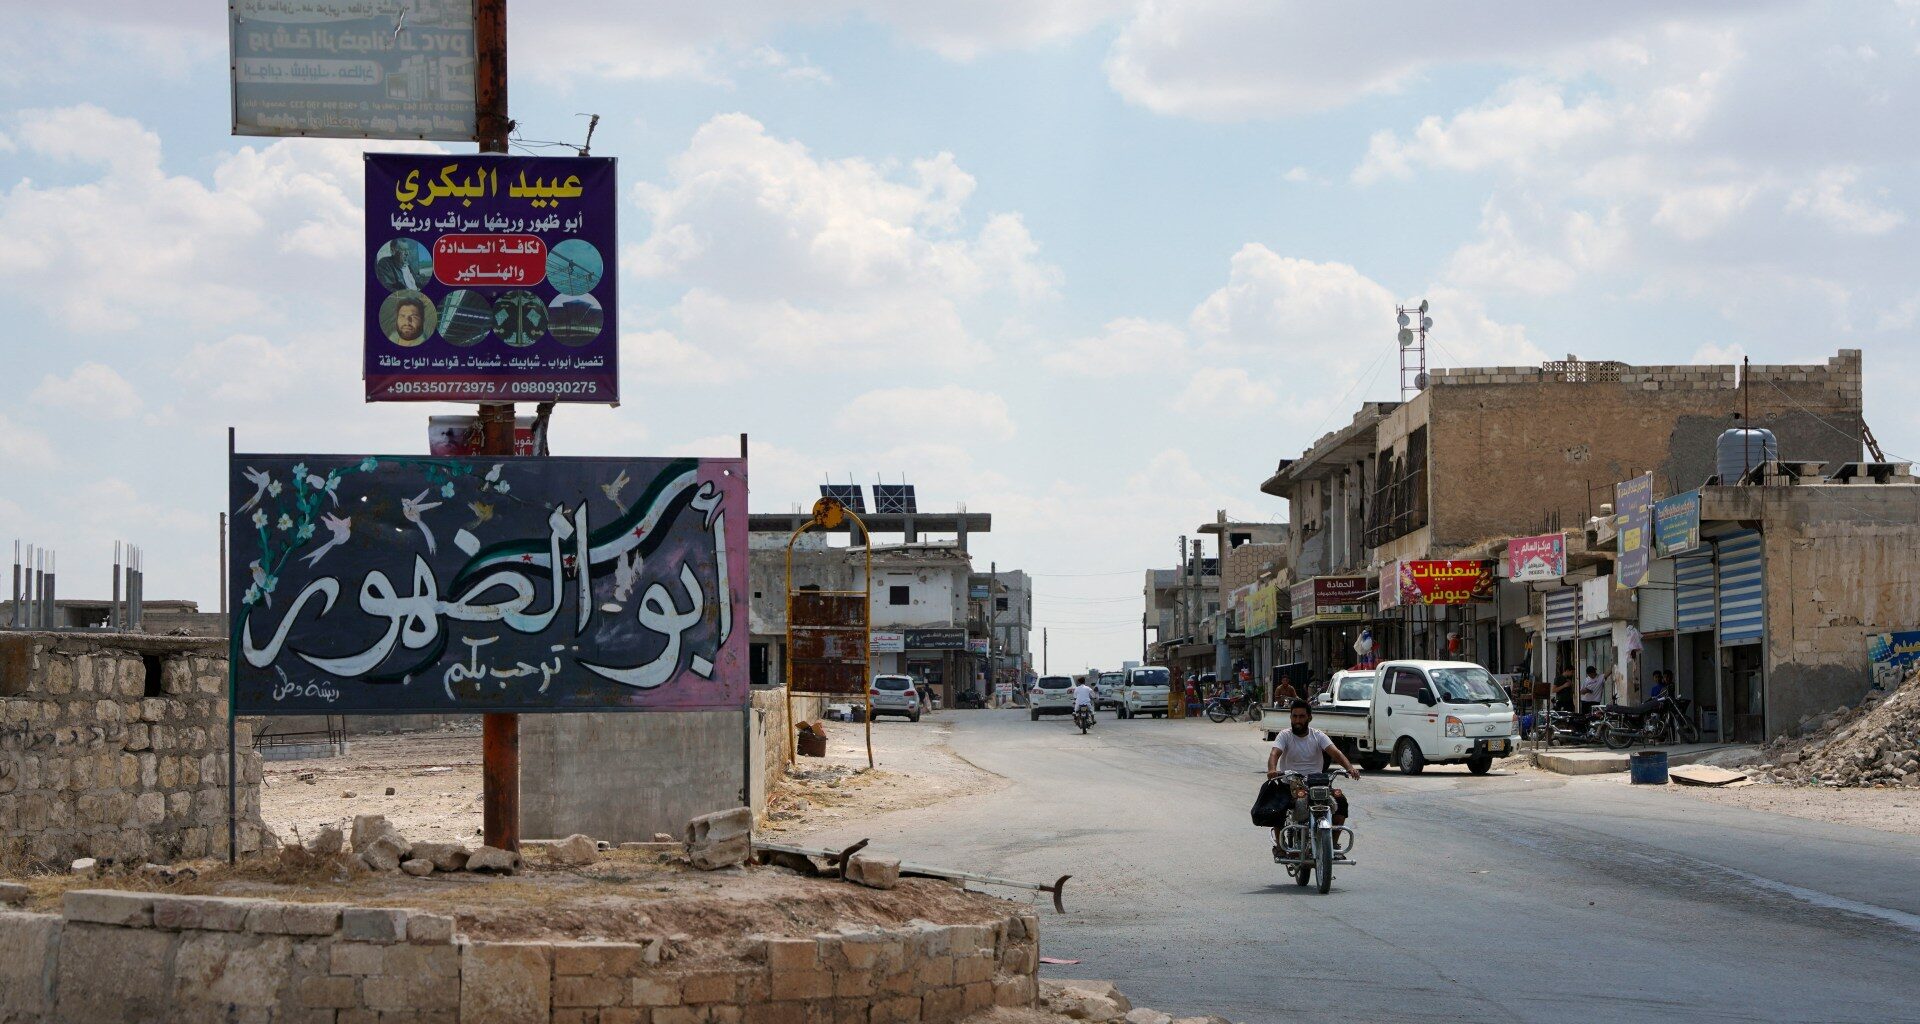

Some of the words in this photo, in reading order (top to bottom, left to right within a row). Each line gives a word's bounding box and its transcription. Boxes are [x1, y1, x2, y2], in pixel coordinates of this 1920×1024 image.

[395, 163, 498, 211] البكري
[509, 169, 584, 208] عبيد
[390, 212, 431, 232] وريفها
[434, 211, 480, 233] سراقب
[484, 212, 523, 233] وريفها
[526, 213, 560, 233] ظهور
[564, 211, 583, 234] أبو
[379, 355, 401, 367] طاقة
[403, 356, 429, 370] اللواح
[432, 356, 459, 369] قواعد
[467, 354, 501, 370] شمسيات
[509, 354, 540, 370] شبابيك
[548, 354, 571, 369] أبواب
[573, 356, 604, 369] تفصيل
[387, 381, 495, 394] +905350773975
[512, 381, 597, 394] 0980930275
[1412, 560, 1481, 581] شعيبيات
[241, 499, 590, 679] الضهور
[577, 480, 734, 689] أبو
[489, 644, 570, 695] ترحب
